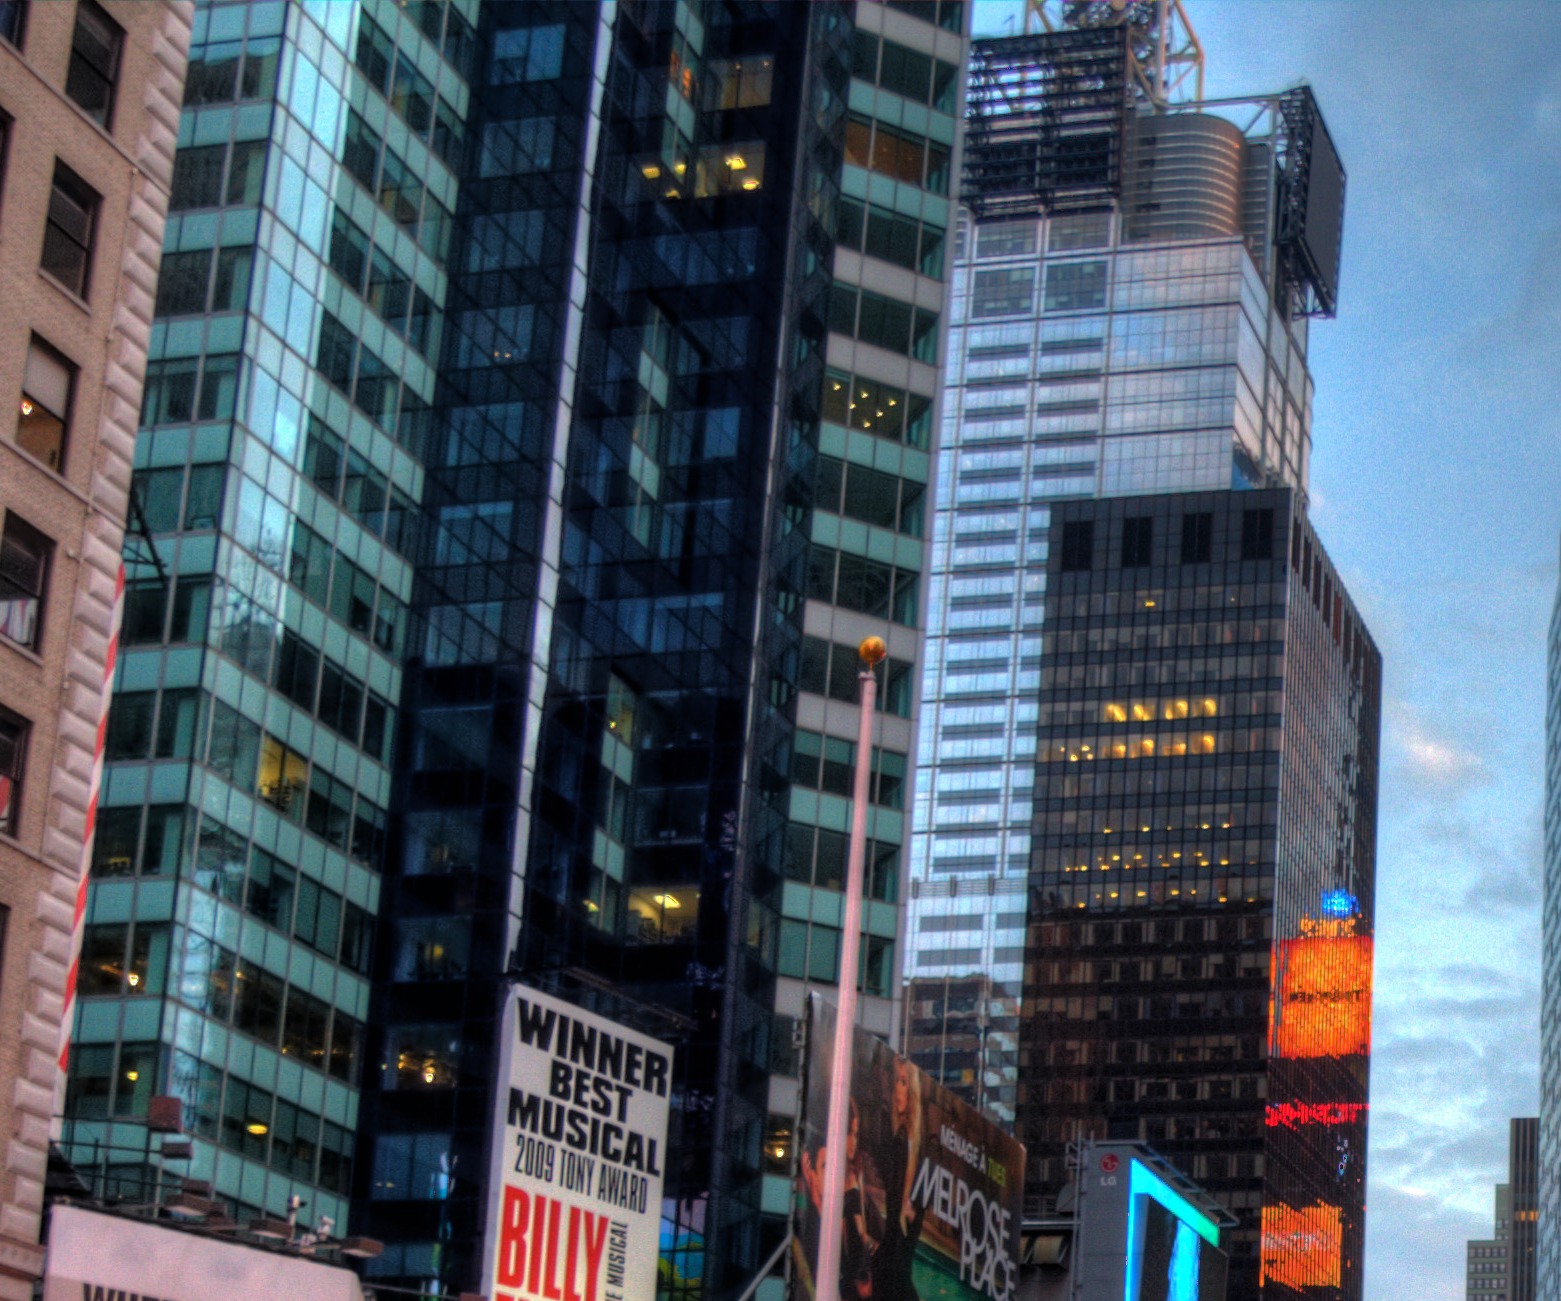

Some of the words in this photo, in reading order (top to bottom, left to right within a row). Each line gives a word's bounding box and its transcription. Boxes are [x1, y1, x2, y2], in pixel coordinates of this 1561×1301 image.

[517, 996, 669, 1098] WINNER
[549, 1058, 634, 1124] BEST
[507, 1087, 661, 1177] MUSICAL
[514, 1134, 556, 1183] 2009
[559, 1148, 596, 1197] TONY
[597, 1163, 648, 1215] AWARD
[910, 1156, 1012, 1260] MELROSE
[1101, 1176, 1117, 1187] LG
[607, 1220, 629, 1288] MUSICAL
